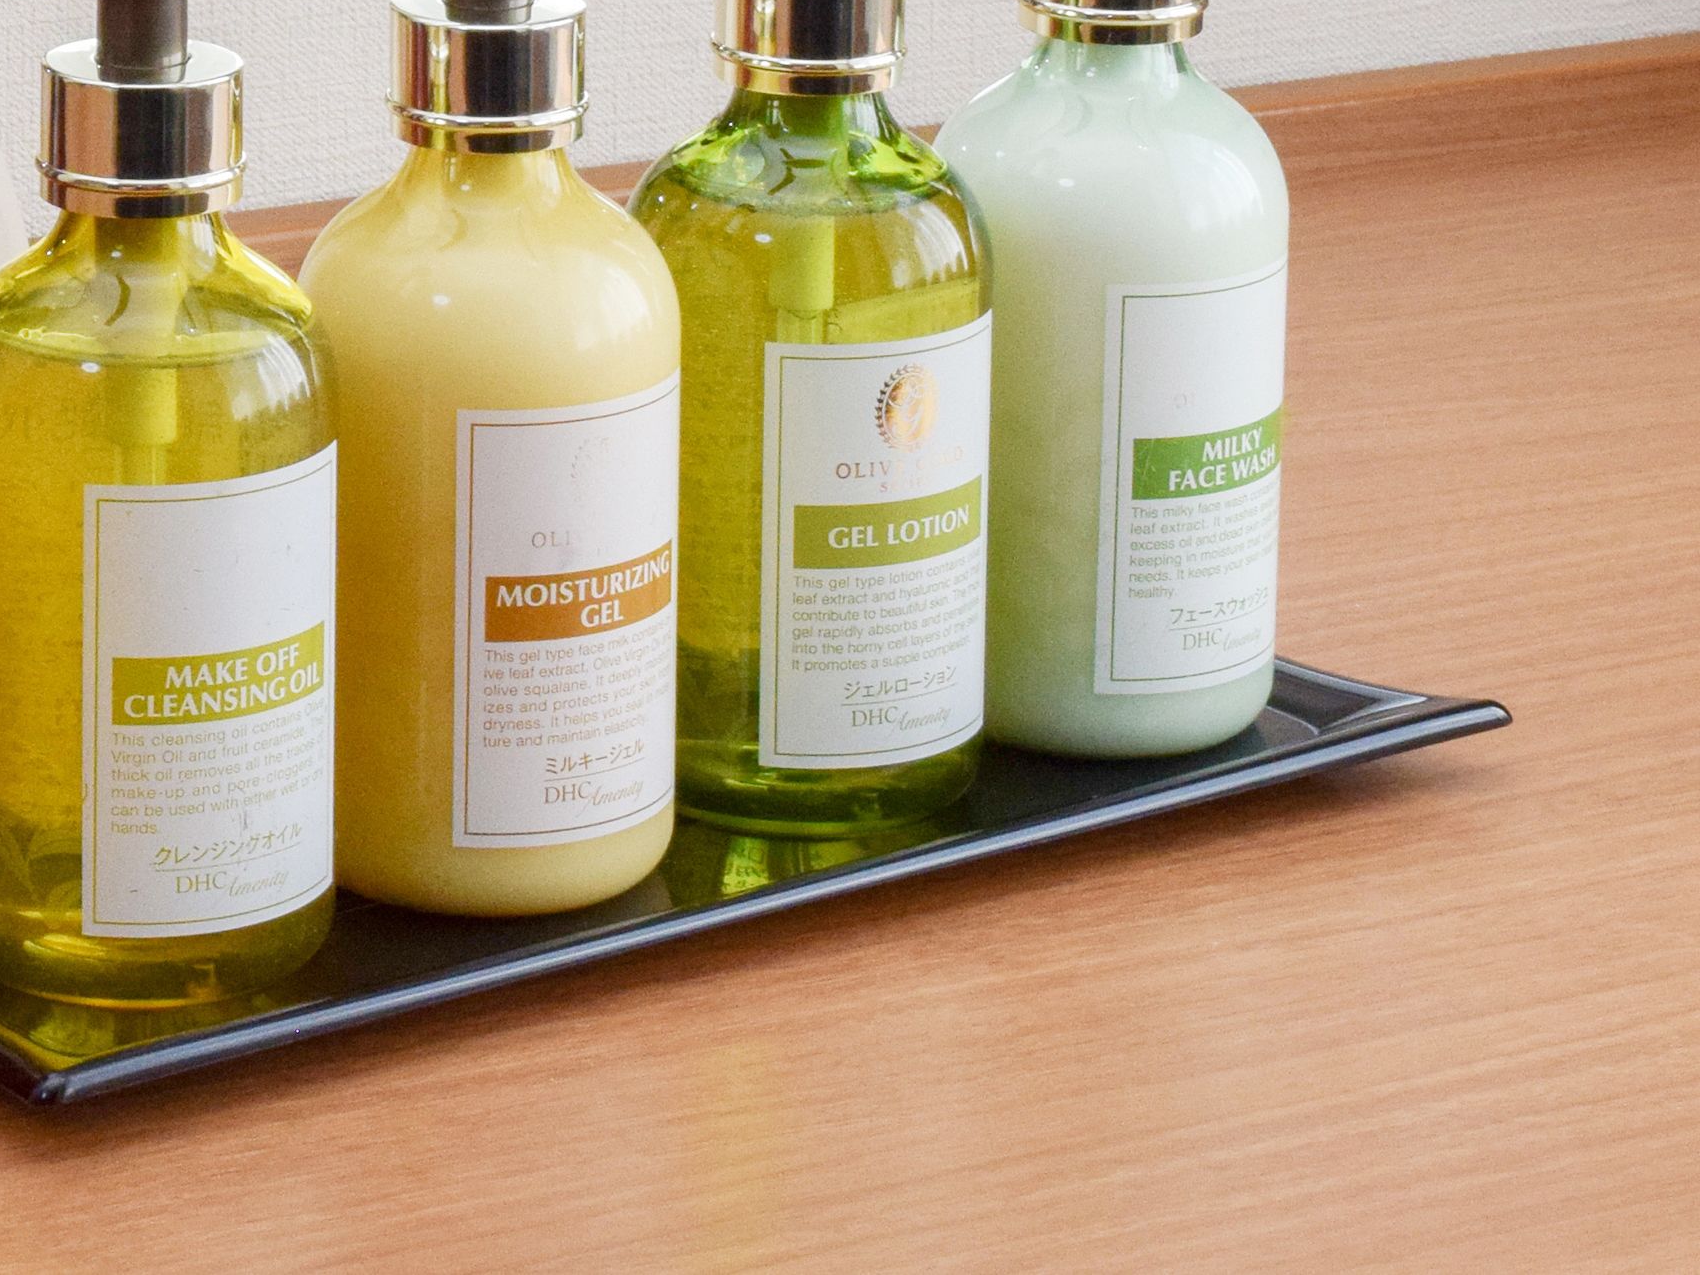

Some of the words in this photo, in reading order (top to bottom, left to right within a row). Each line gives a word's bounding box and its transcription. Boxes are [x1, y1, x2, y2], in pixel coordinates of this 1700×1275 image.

[1203, 426, 1263, 461] MILKY
[1168, 464, 1226, 491] FACE
[1232, 444, 1276, 481] WASH
[1131, 507, 1158, 518] This
[1163, 505, 1194, 518] milky
[1197, 502, 1221, 513] face
[828, 525, 878, 549] GEL
[887, 505, 970, 546] LOTION
[1129, 540, 1175, 551] excess
[1179, 536, 1192, 548] oil
[1195, 534, 1216, 546] and
[1219, 526, 1243, 542] dead
[1130, 523, 1155, 535] leaf
[1213, 517, 1220, 527] It
[531, 531, 571, 548] OLI
[1129, 554, 1182, 568] keeping
[1186, 553, 1197, 562] in
[496, 549, 669, 607] MOISTURIZING
[794, 576, 823, 589] This
[829, 577, 849, 591] gel
[855, 575, 884, 589] type
[890, 568, 923, 584] lotion
[1129, 571, 1172, 583] needs.
[1177, 569, 1184, 580] It
[1188, 565, 1221, 579] keeps
[792, 592, 817, 605] leaf
[822, 593, 868, 605] extract
[871, 589, 895, 603] and
[899, 579, 951, 599] hyaluronic
[581, 601, 623, 628] GEL
[792, 610, 860, 621] contribute
[864, 609, 875, 620] to
[880, 599, 927, 619] beautiful
[792, 626, 812, 640] gel
[818, 626, 863, 640] rapidly
[868, 619, 917, 637] absorbs
[922, 615, 941, 628] and
[1182, 629, 1222, 651] DHC
[485, 650, 514, 662] This
[520, 650, 540, 664] gel
[546, 647, 573, 662] type
[579, 643, 604, 656] face
[608, 635, 629, 650] milk
[792, 643, 817, 655] into
[822, 642, 844, 654] the
[887, 638, 908, 650] cell
[911, 629, 940, 647] layers
[166, 659, 248, 688] MAKE
[256, 643, 299, 675] OFF
[484, 667, 504, 679] ive
[509, 666, 534, 679] leaf
[593, 656, 621, 670] Olive
[792, 659, 800, 670] It
[804, 657, 866, 672] promotes
[871, 659, 878, 669] a
[882, 652, 920, 669] supple
[124, 677, 285, 718] CLEANSING
[289, 662, 319, 693] OIL
[483, 684, 517, 697] olive
[524, 679, 591, 697] squalane.
[596, 676, 604, 686] It
[843, 666, 956, 700] ジェルローション
[483, 702, 513, 713] izes
[519, 700, 547, 712] and
[553, 692, 608, 711] protects
[612, 685, 636, 702] your
[111, 732, 144, 746] This
[151, 730, 226, 746] cleansing
[232, 726, 247, 739] oil
[252, 713, 301, 734] contains
[483, 719, 545, 732] dryness.
[551, 717, 559, 727] It
[564, 711, 598, 726] helps
[603, 705, 622, 720] you
[851, 706, 899, 727] DHC
[484, 735, 511, 748] ture
[516, 734, 542, 746] and
[547, 726, 601, 745] maintain
[111, 750, 156, 766] Virgin
[162, 750, 182, 763] Oil
[189, 748, 216, 762] and
[222, 741, 248, 758] fruit
[112, 769, 149, 782] thick
[155, 768, 172, 781] oil
[178, 762, 240, 780] removes
[245, 759, 260, 772] all
[264, 750, 283, 765] the
[545, 739, 644, 775] ミルキージェル
[111, 785, 184, 800] make-up
[193, 782, 220, 796] and
[111, 805, 139, 816] can
[144, 803, 162, 817] be
[169, 801, 205, 816] used
[210, 796, 239, 811] with
[243, 787, 276, 806] either
[544, 781, 592, 805] DHC
[575, 779, 644, 818] Amenity
[155, 823, 300, 866] クレンジングオイル
[175, 871, 227, 893] DHC
[229, 870, 288, 897] Amenity
